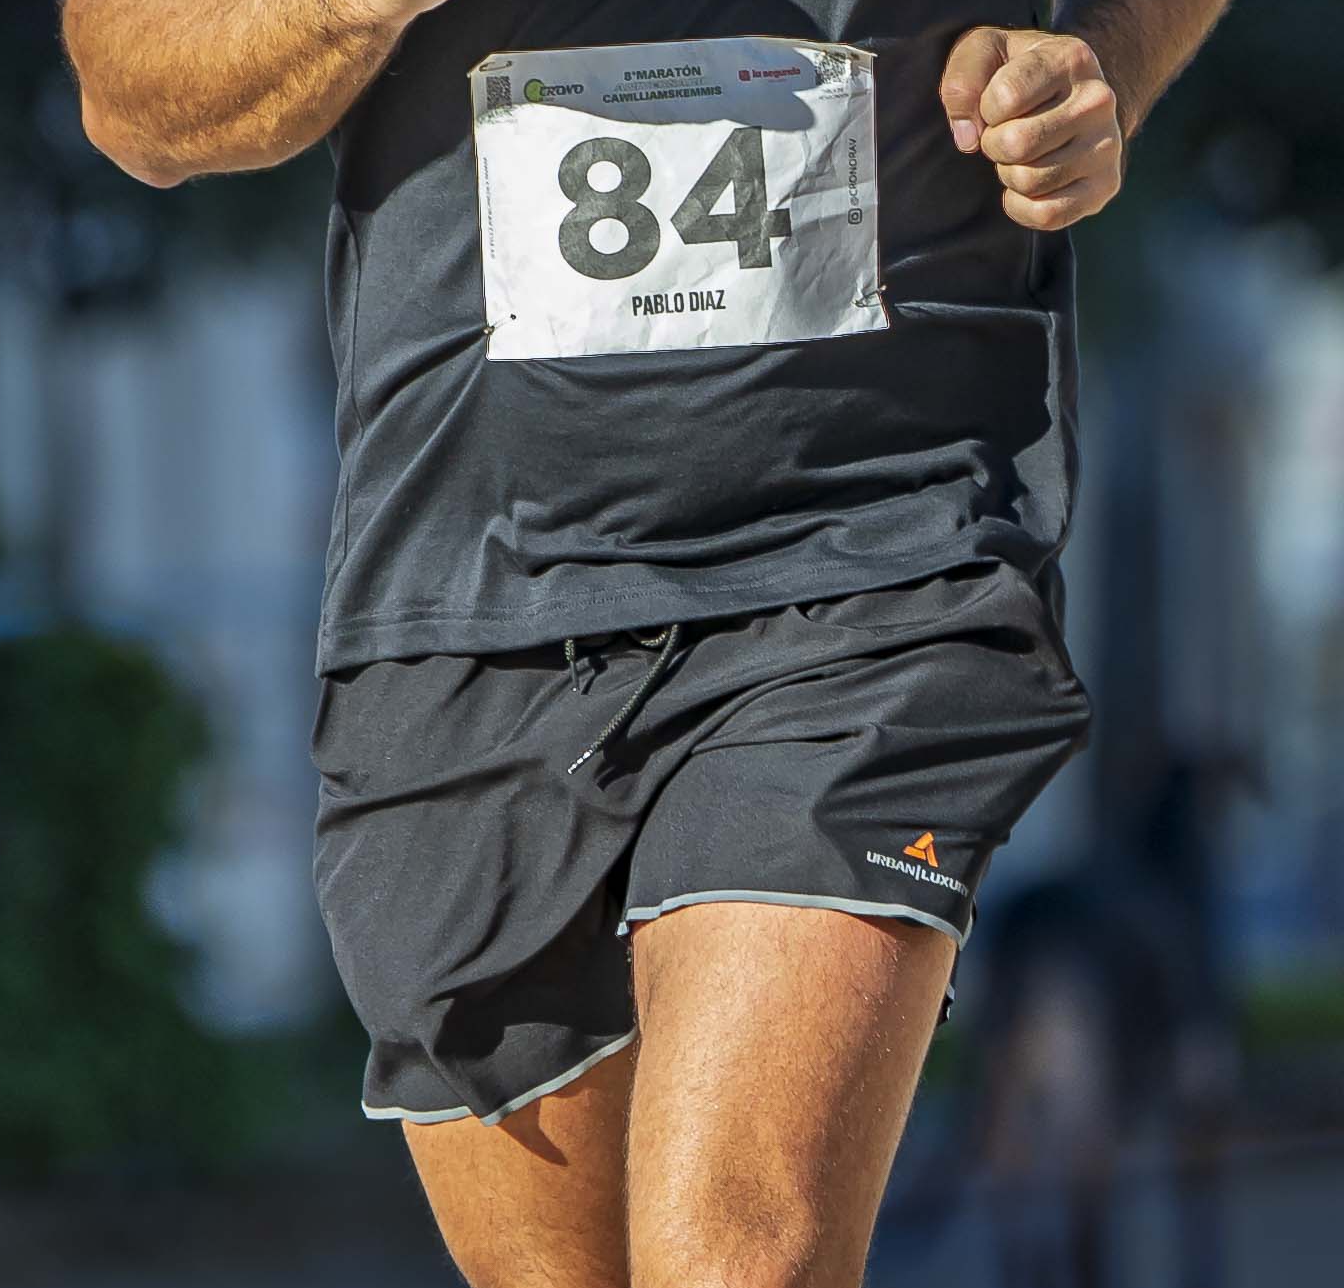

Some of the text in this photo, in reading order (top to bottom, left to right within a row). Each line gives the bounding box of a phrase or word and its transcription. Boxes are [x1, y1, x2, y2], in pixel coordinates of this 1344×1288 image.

[557, 124, 793, 281] 84
[631, 289, 726, 317] PABLO DIAZ
